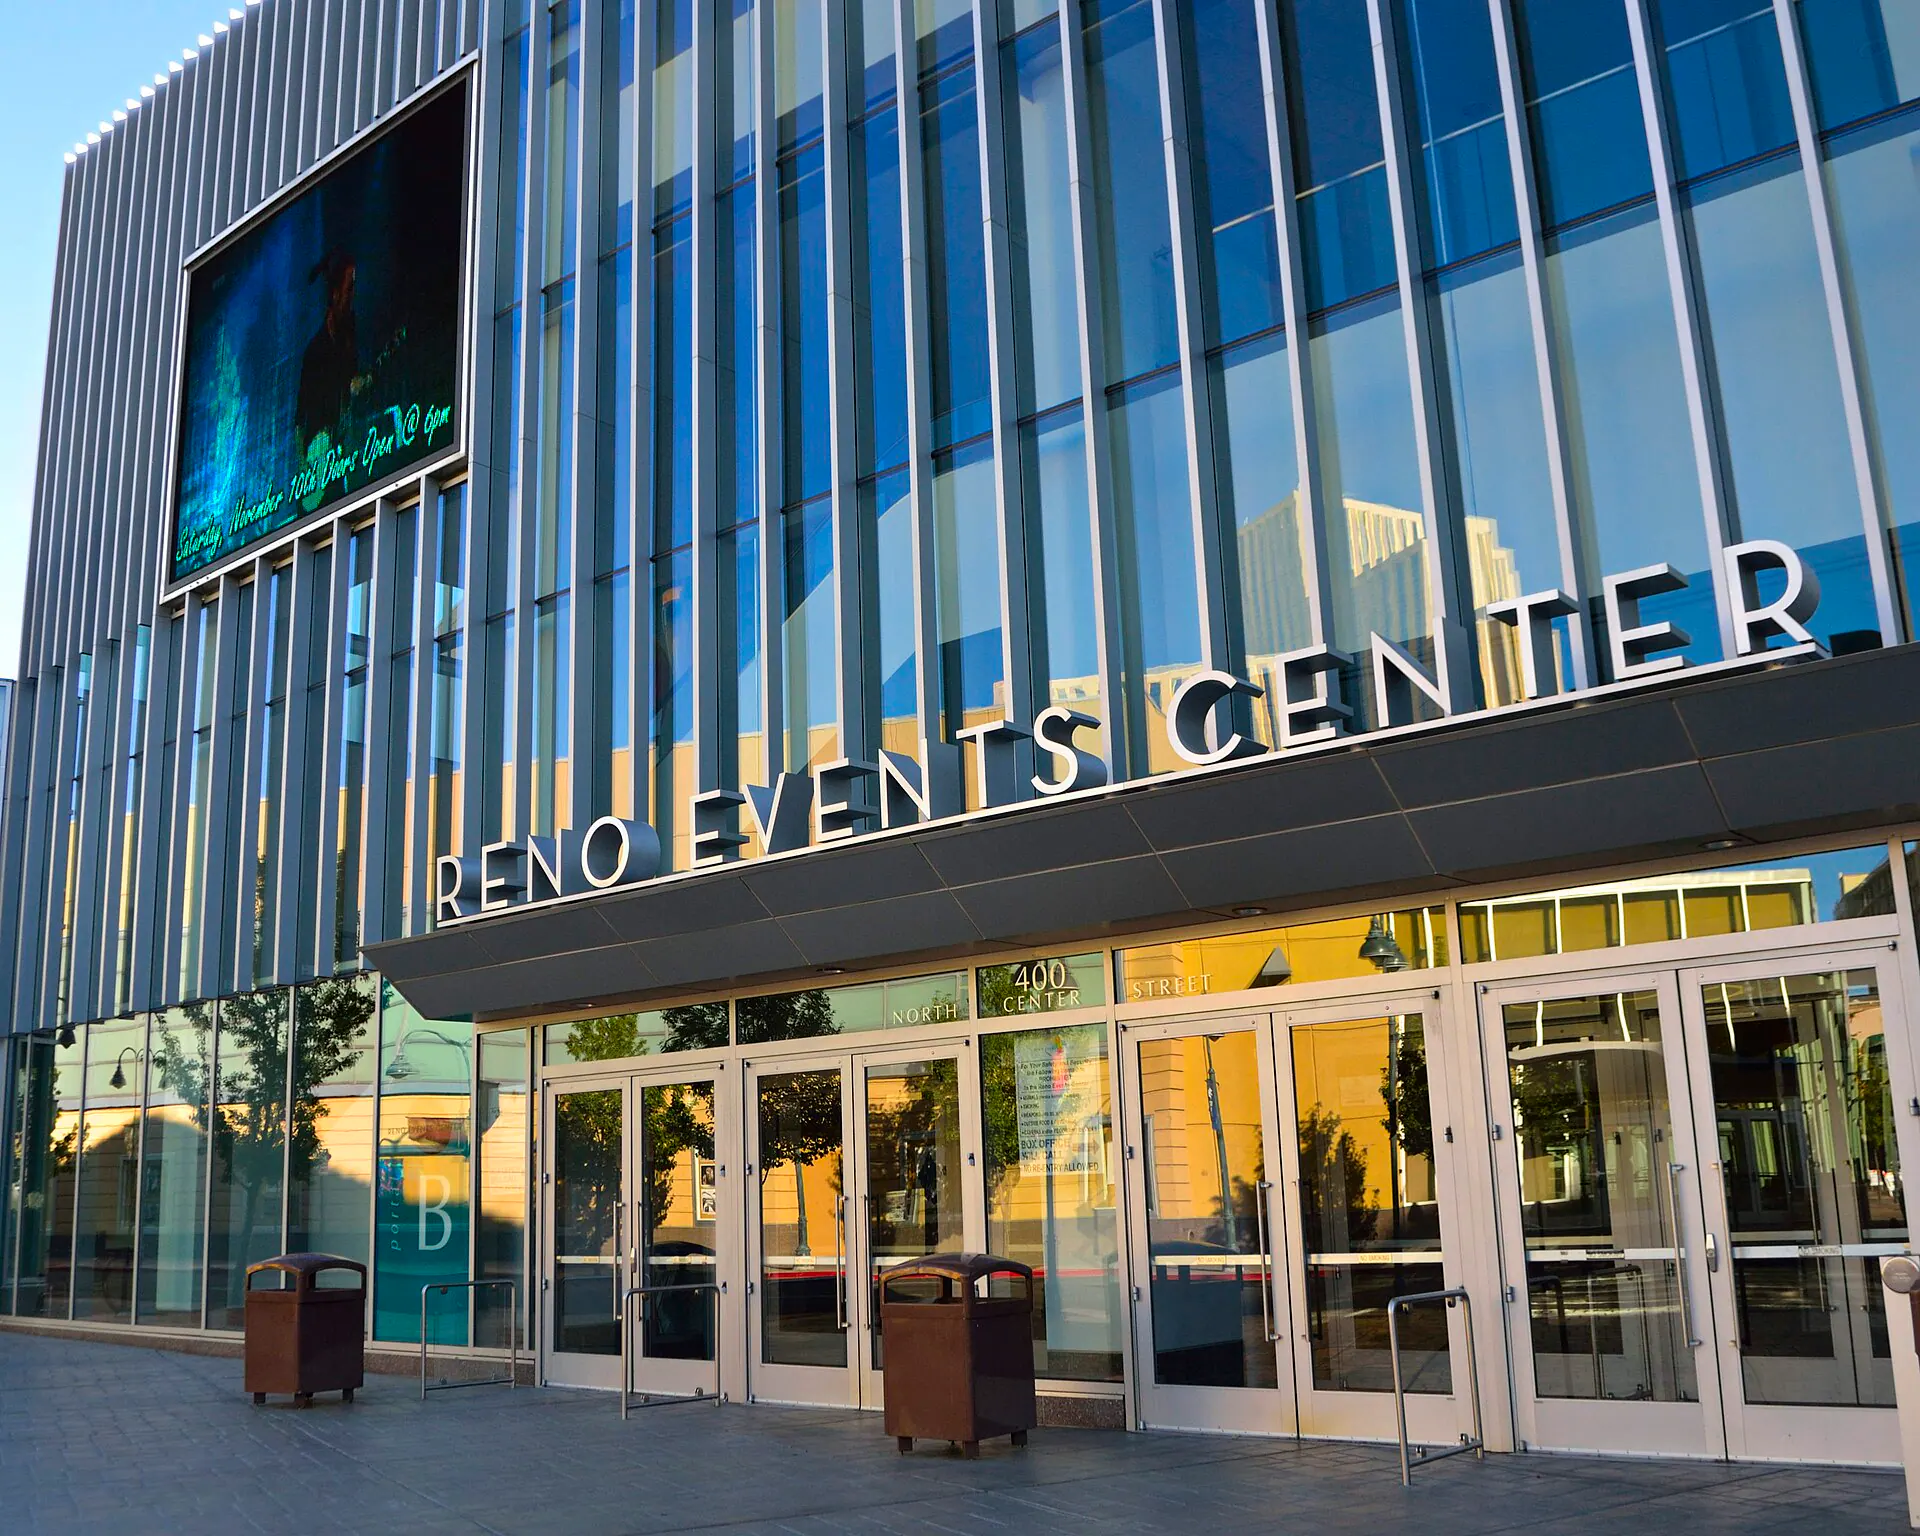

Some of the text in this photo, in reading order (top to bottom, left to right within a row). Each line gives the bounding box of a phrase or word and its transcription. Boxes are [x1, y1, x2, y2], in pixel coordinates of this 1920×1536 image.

[176, 403, 451, 562] Saturday, November 10th Doors Open @ 6pm
[436, 539, 1814, 921] RENO EVENTS CENTER
[1014, 961, 1067, 992] 400
[892, 973, 1213, 1025] NORTH CENTER STREET
[1021, 1138, 1070, 1149] BOX OFFICE
[1021, 1150, 1062, 1160] WILL CALL
[1024, 1162, 1099, 1173] NO RE-ENTRY ALLOWED
[418, 1174, 453, 1251] B
